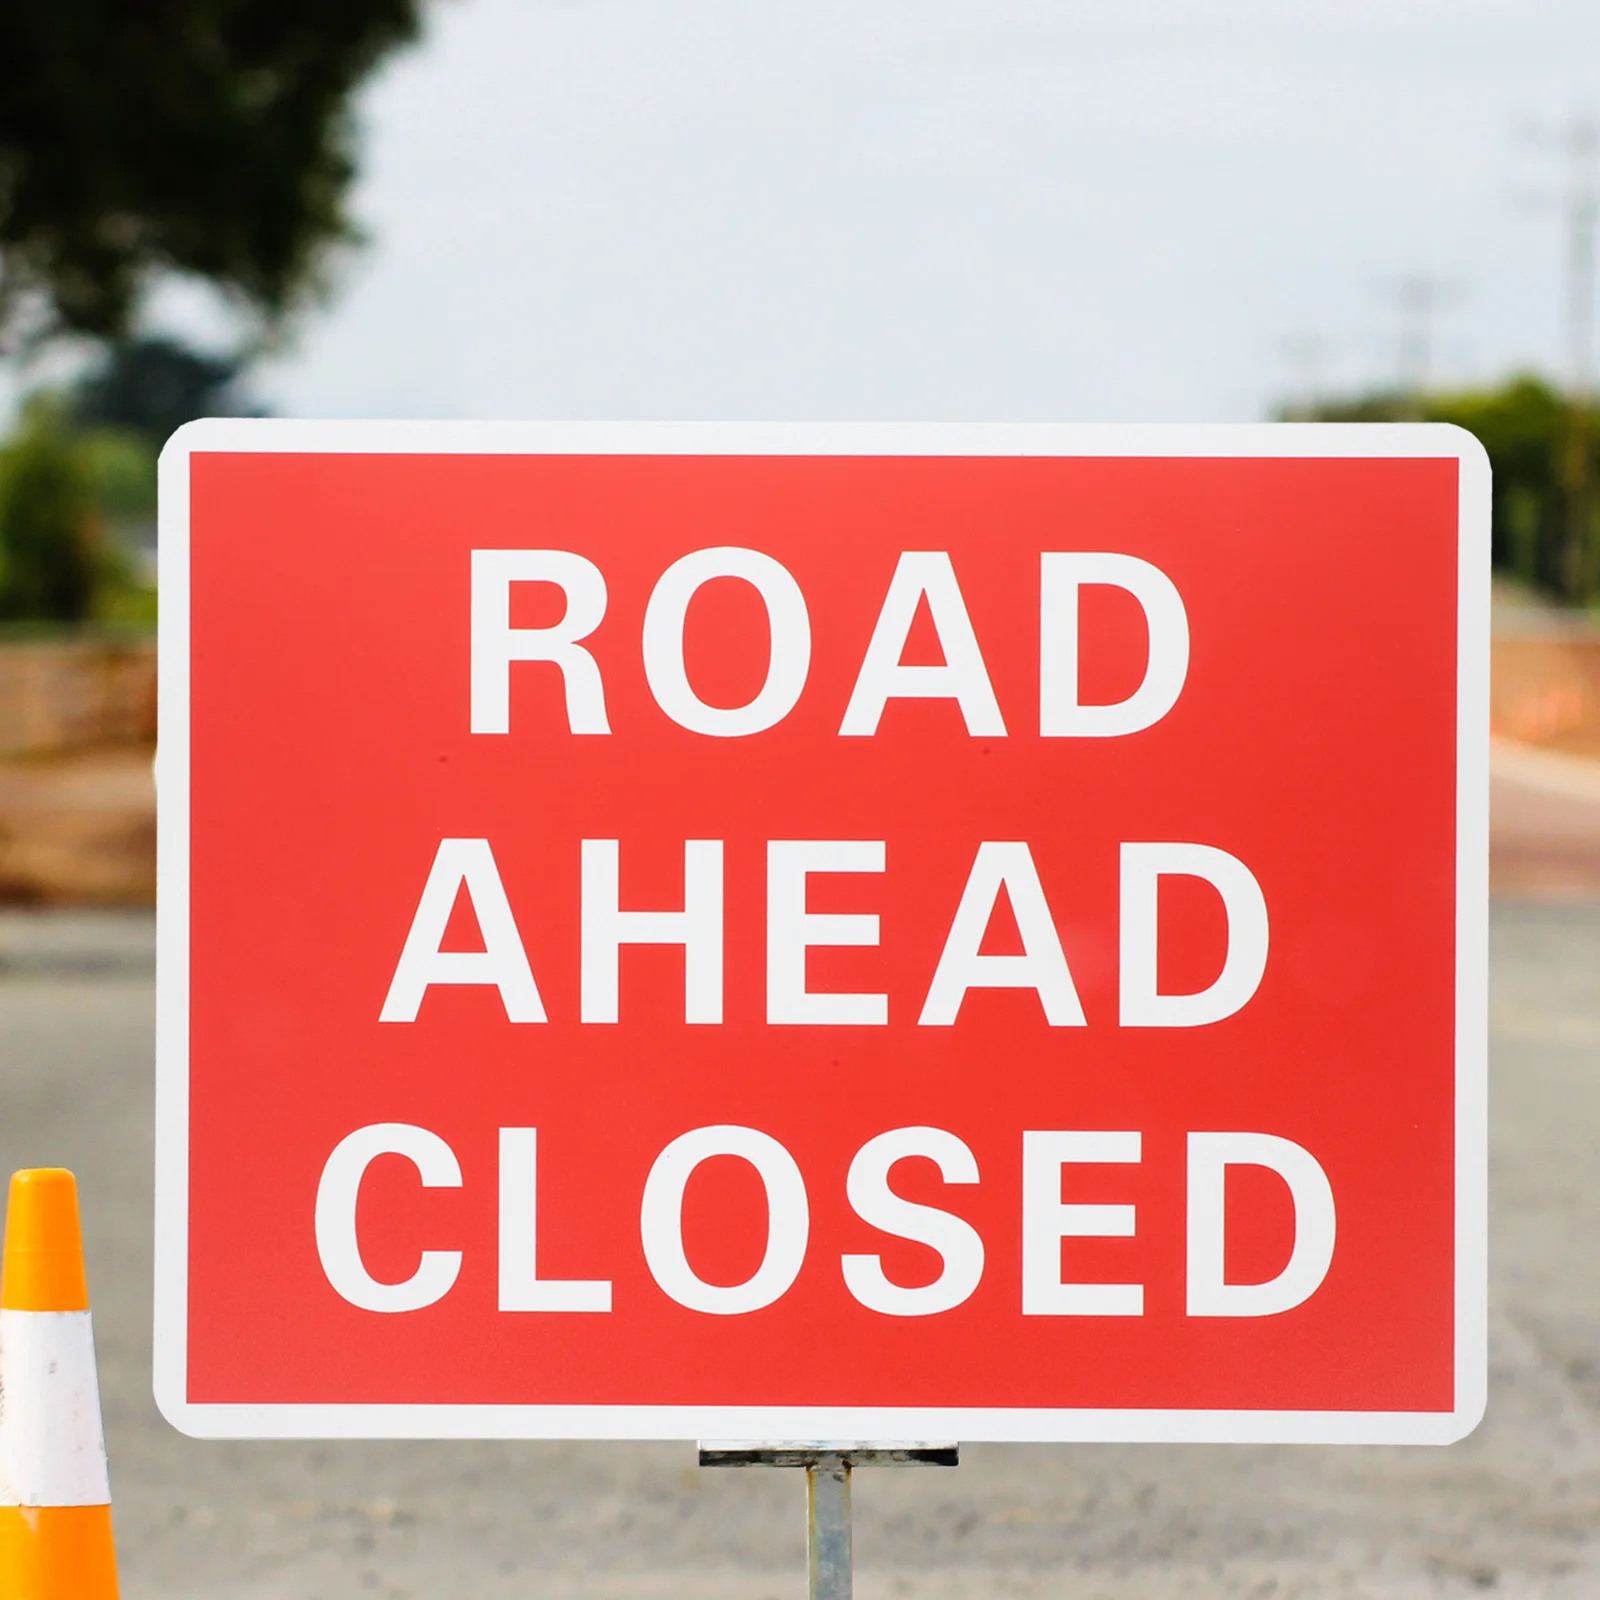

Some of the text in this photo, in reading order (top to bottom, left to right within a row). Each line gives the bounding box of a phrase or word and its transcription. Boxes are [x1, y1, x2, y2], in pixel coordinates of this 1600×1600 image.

[471, 546, 1189, 737] ROAD
[379, 838, 1269, 1027] AHEAD
[315, 1123, 1336, 1316] CLOSED
